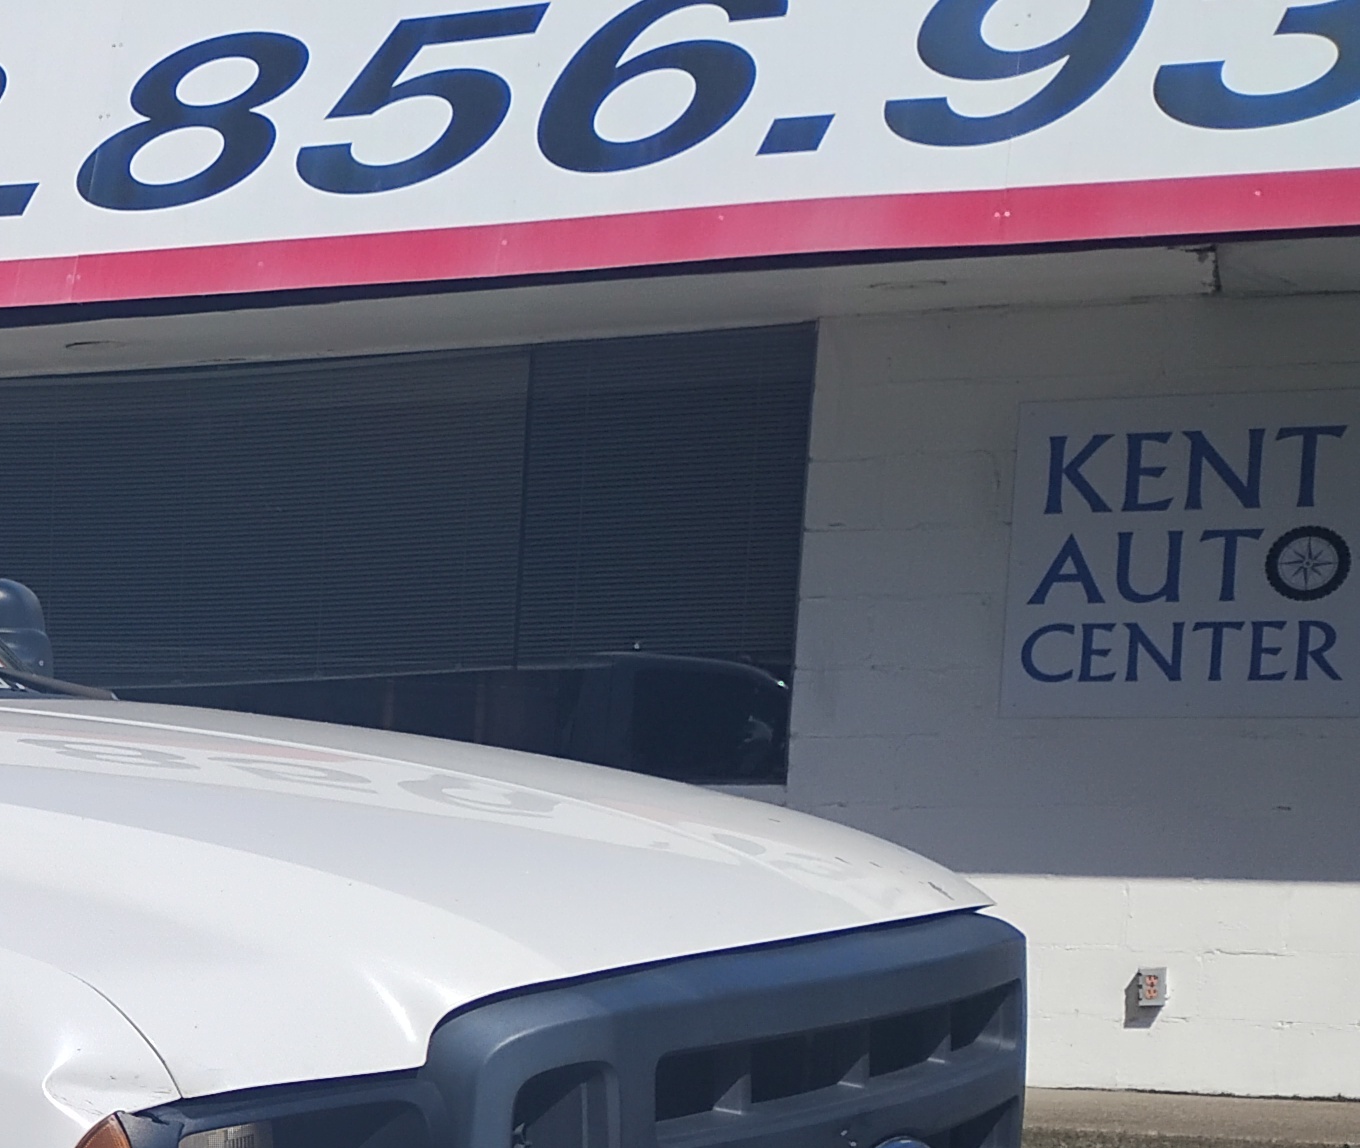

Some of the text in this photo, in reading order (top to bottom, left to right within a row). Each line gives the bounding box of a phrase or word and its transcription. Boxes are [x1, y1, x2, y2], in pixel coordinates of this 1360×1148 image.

[1043, 424, 1349, 515] KENT
[1026, 525, 1352, 605] AUTO
[1020, 620, 1343, 683] CENTER
